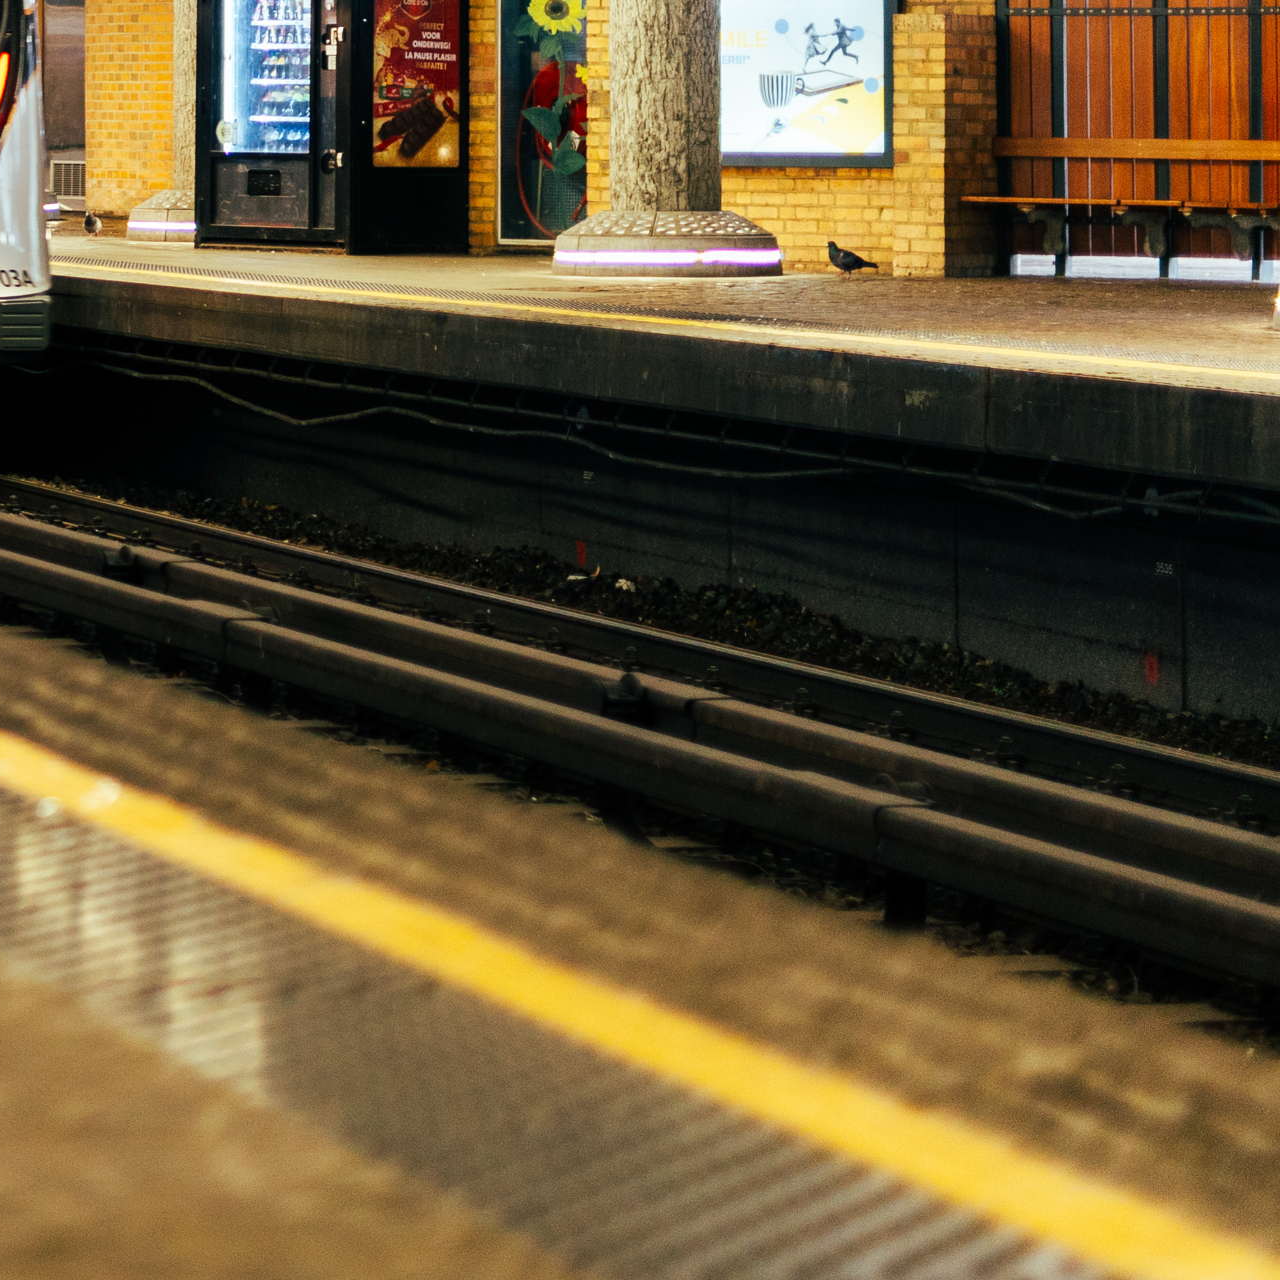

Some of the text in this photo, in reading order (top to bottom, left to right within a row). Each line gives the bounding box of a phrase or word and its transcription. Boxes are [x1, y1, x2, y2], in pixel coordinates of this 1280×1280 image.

[421, 31, 441, 40] VOOR
[412, 38, 451, 50] ONDERWEG!
[405, 51, 413, 60] LA
[414, 52, 433, 61] PAUSE
